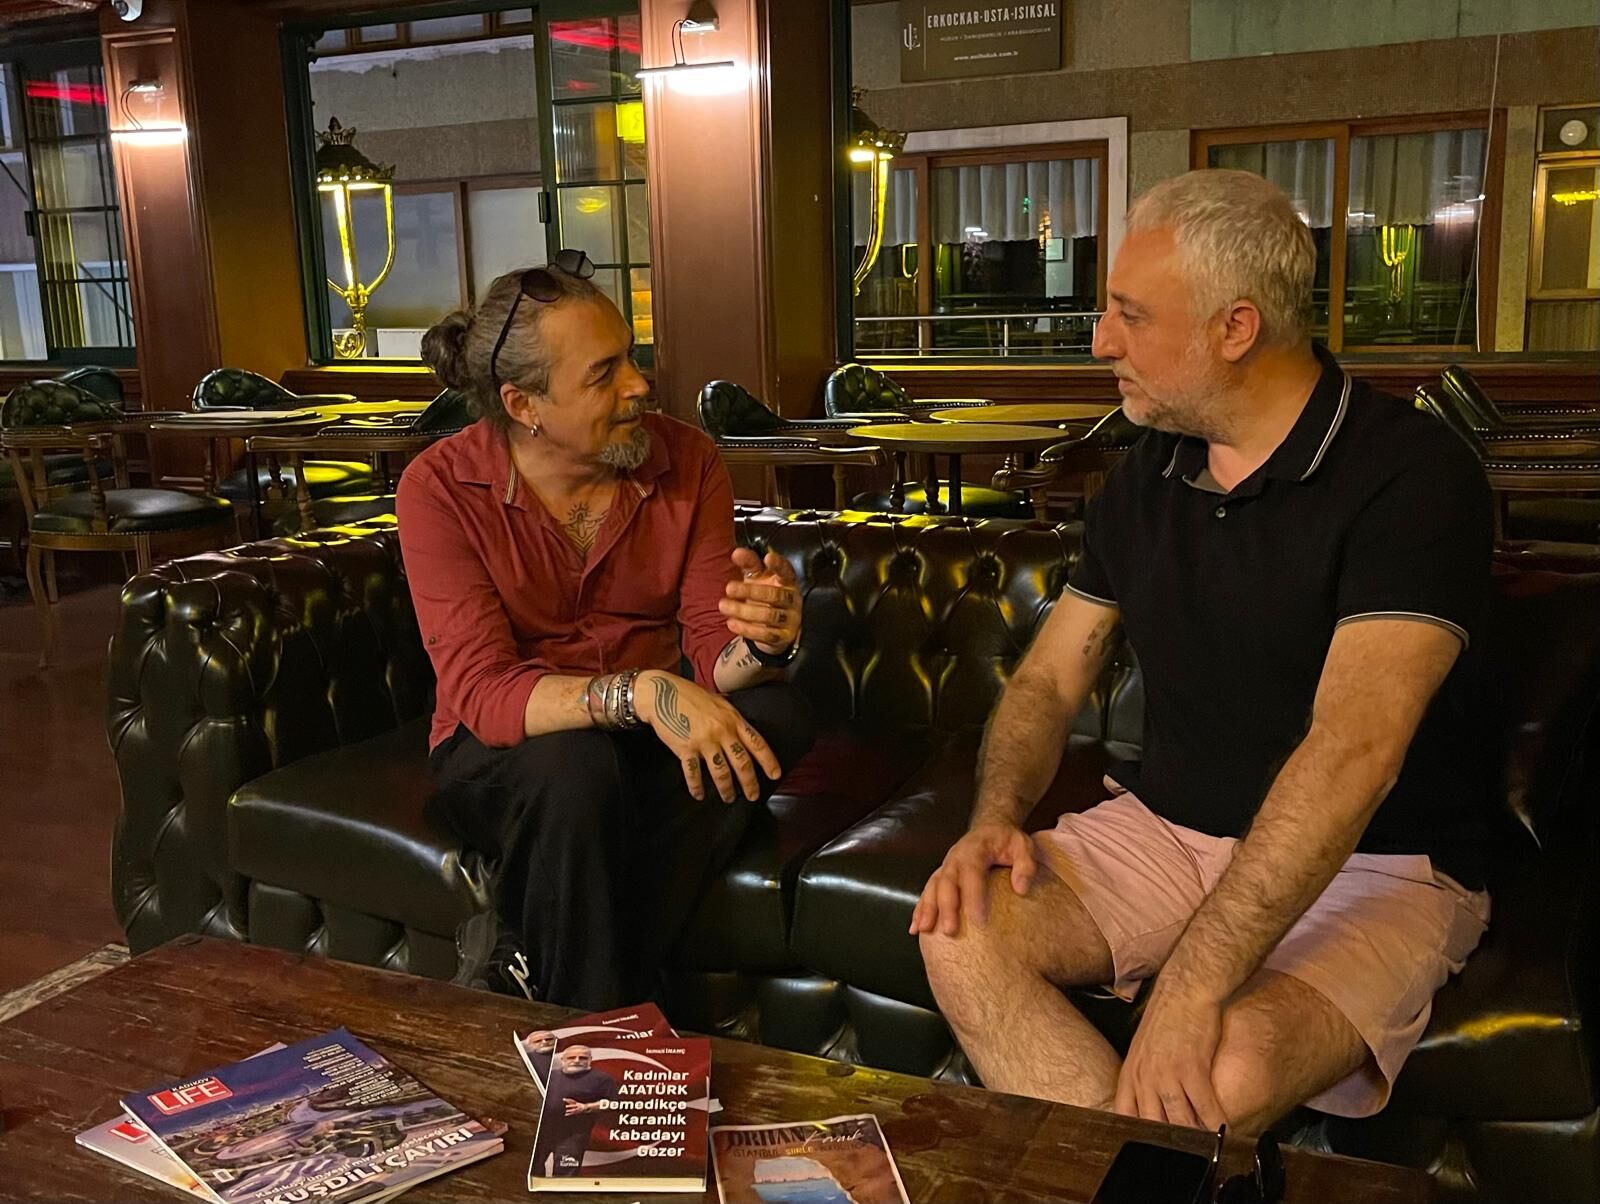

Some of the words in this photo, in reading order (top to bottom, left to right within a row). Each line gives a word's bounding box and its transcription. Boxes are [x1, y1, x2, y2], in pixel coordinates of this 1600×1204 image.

[624, 1070, 689, 1081] Kadınlar
[618, 1082, 688, 1095] ATATÜRK
[152, 1080, 227, 1111] LIFE
[599, 1099, 687, 1112] Demedikçe
[618, 1114, 686, 1125] Karanlık
[609, 1129, 685, 1143] Kabadayı
[385, 1128, 474, 1168] ÇAYIRI
[637, 1145, 685, 1157] Gezer
